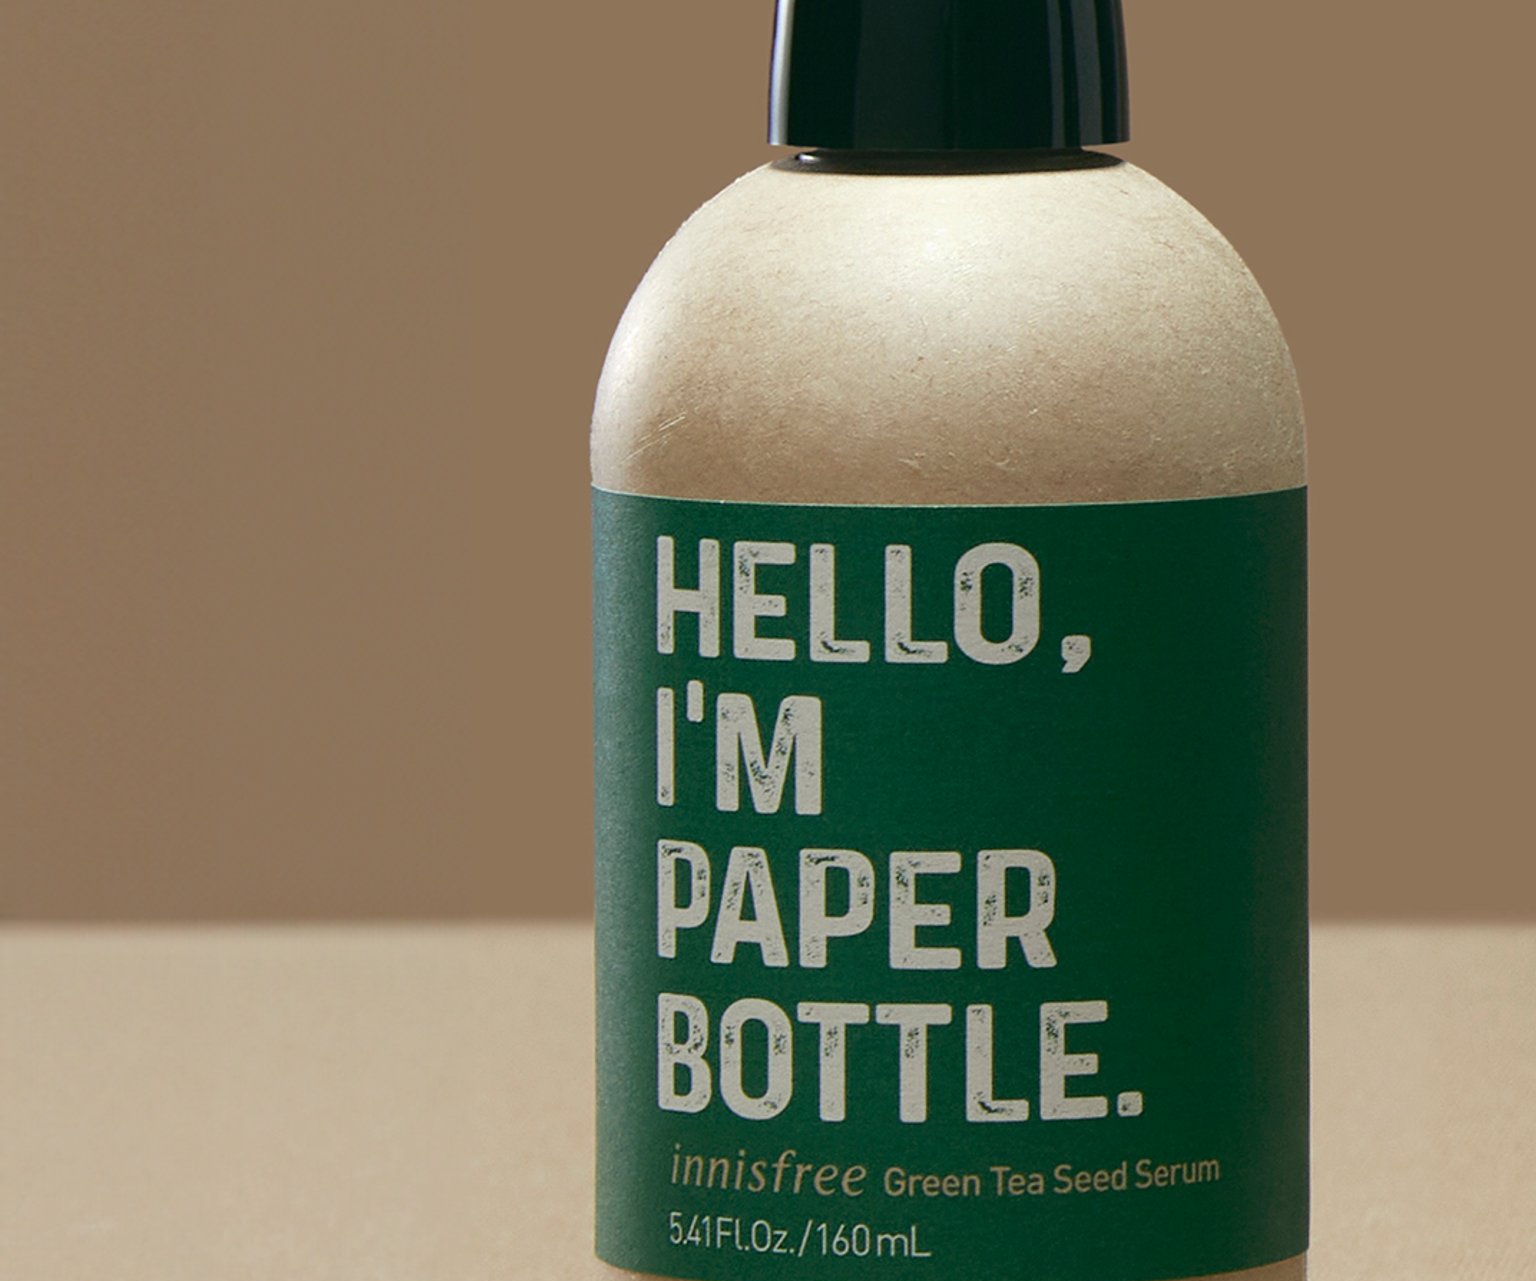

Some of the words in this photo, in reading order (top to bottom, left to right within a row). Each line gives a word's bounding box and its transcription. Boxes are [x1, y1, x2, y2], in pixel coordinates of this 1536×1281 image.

[656, 535, 1091, 673] HELLO,
[657, 680, 822, 815] I'M
[657, 839, 1057, 969] PAPER
[657, 992, 1143, 1123] BOTTLE.
[672, 1143, 866, 1196] innisfree
[884, 1167, 980, 1196] Green
[990, 1166, 1044, 1195] Tea
[1054, 1161, 1127, 1193] Seed
[1136, 1159, 1219, 1188] Serum
